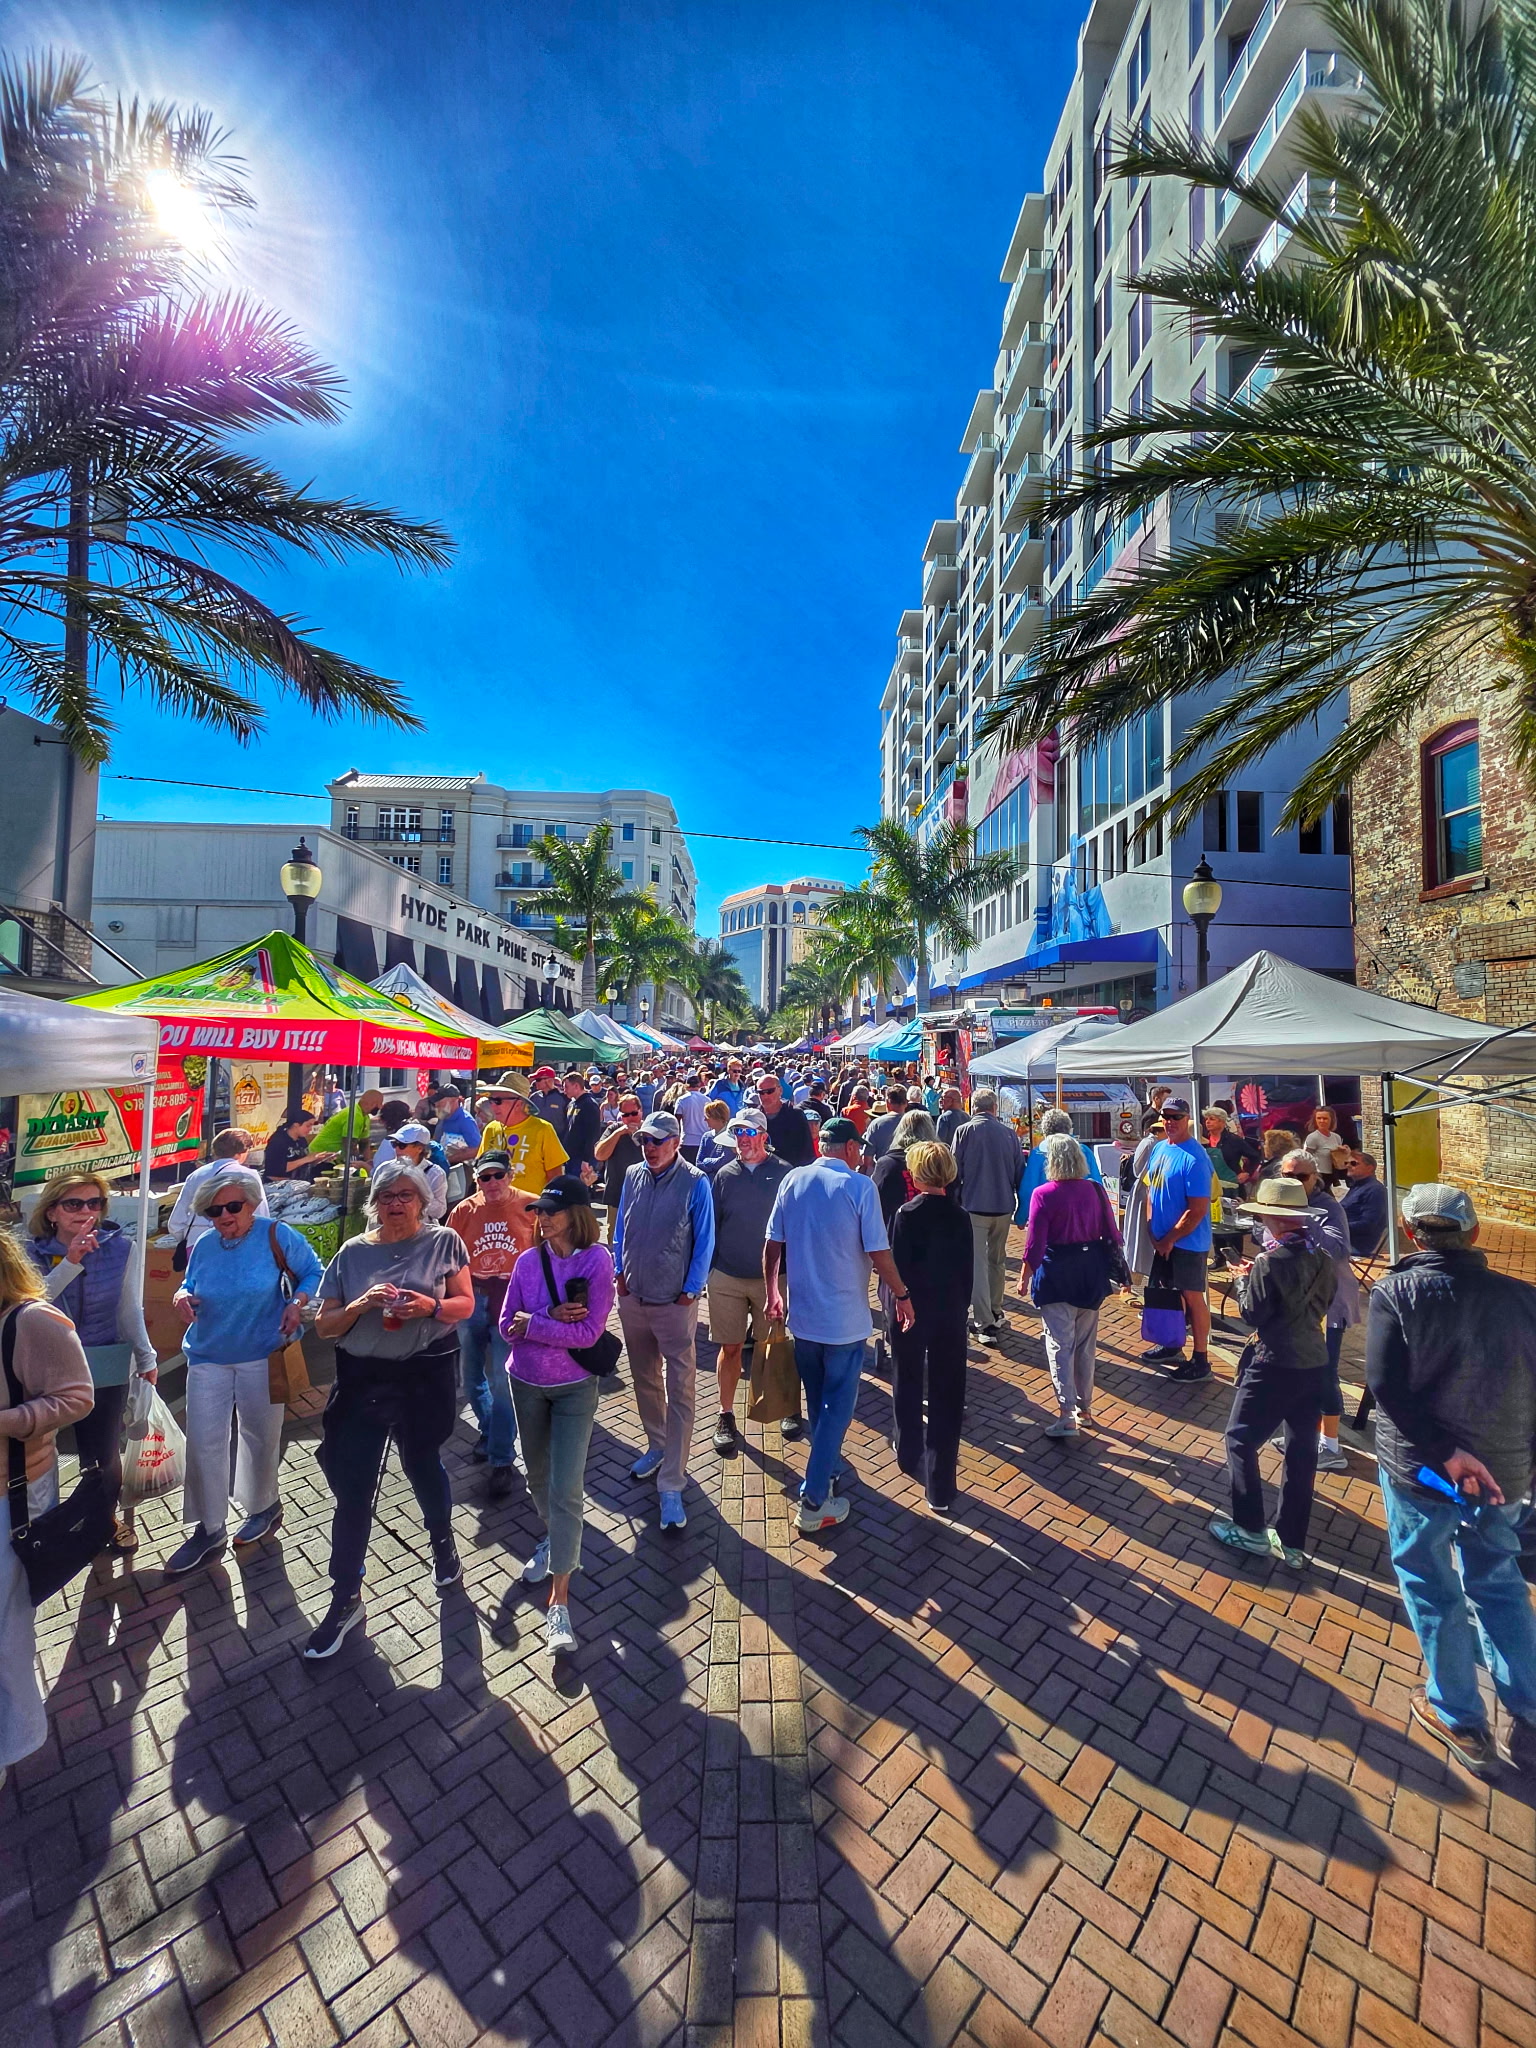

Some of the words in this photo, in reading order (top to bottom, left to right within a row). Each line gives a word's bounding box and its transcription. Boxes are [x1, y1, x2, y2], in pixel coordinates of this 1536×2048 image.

[400, 893, 448, 933] HYDE
[456, 917, 491, 949] PARK
[497, 935, 528, 963] PRIME
[159, 1024, 189, 1047] OU
[190, 1026, 235, 1048] WILL
[238, 1027, 281, 1049] BUY
[282, 1030, 328, 1052] IT!!!
[371, 1036, 396, 1055] 100%
[395, 1039, 419, 1059] VEGAN,
[418, 1041, 442, 1059] ORGANIC
[26, 1111, 109, 1138] DYNASTY
[33, 1130, 100, 1149] GUACAMOLE
[91, 1147, 138, 1172] GUACAMOLE
[483, 1221, 509, 1234] 100%
[472, 1242, 494, 1257] CLAY
[495, 1241, 519, 1255] BODY
[473, 1233, 517, 1247] NATURAL
